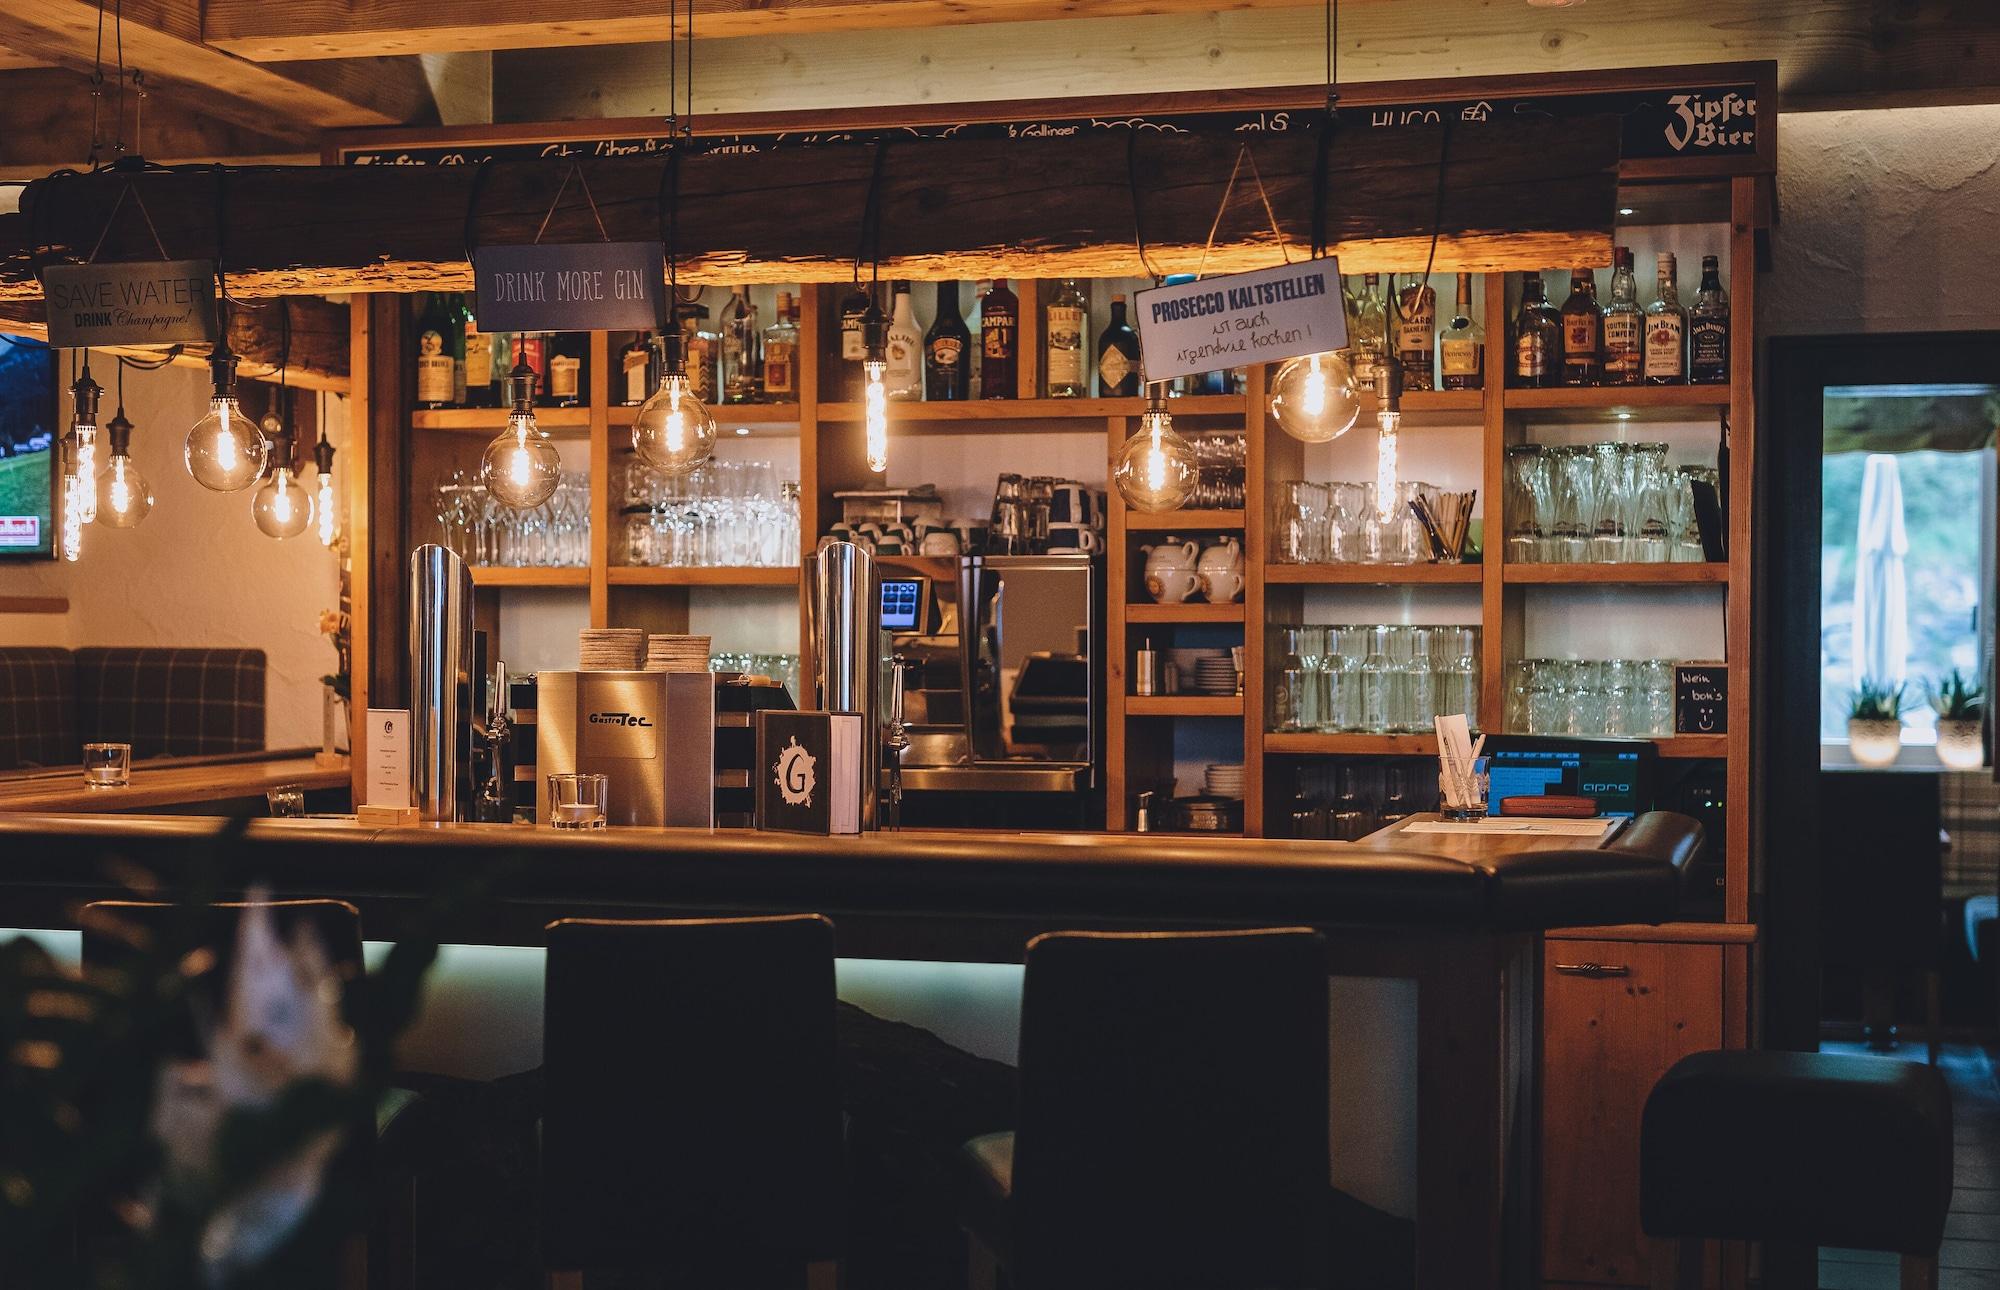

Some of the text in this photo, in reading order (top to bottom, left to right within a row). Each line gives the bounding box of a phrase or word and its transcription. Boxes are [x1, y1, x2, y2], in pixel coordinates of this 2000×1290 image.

[1664, 93, 1756, 151] Zipfer
[1693, 122, 1754, 147] Bier
[53, 278, 206, 311] SAVE WATER
[494, 268, 645, 303] DRINK MORE GIN
[1151, 273, 1326, 324] PROSECCO KALTSTELLEN
[75, 307, 193, 332] DRINK Champagne!
[1235, 310, 1270, 332] auch
[1647, 319, 1680, 336] JIM BEAM
[1608, 330, 1635, 339] COMFORT
[1176, 337, 1247, 365] irgendwie
[1681, 672, 1711, 684] Wein
[589, 712, 653, 727] GastroTec
[785, 753, 806, 794] G
